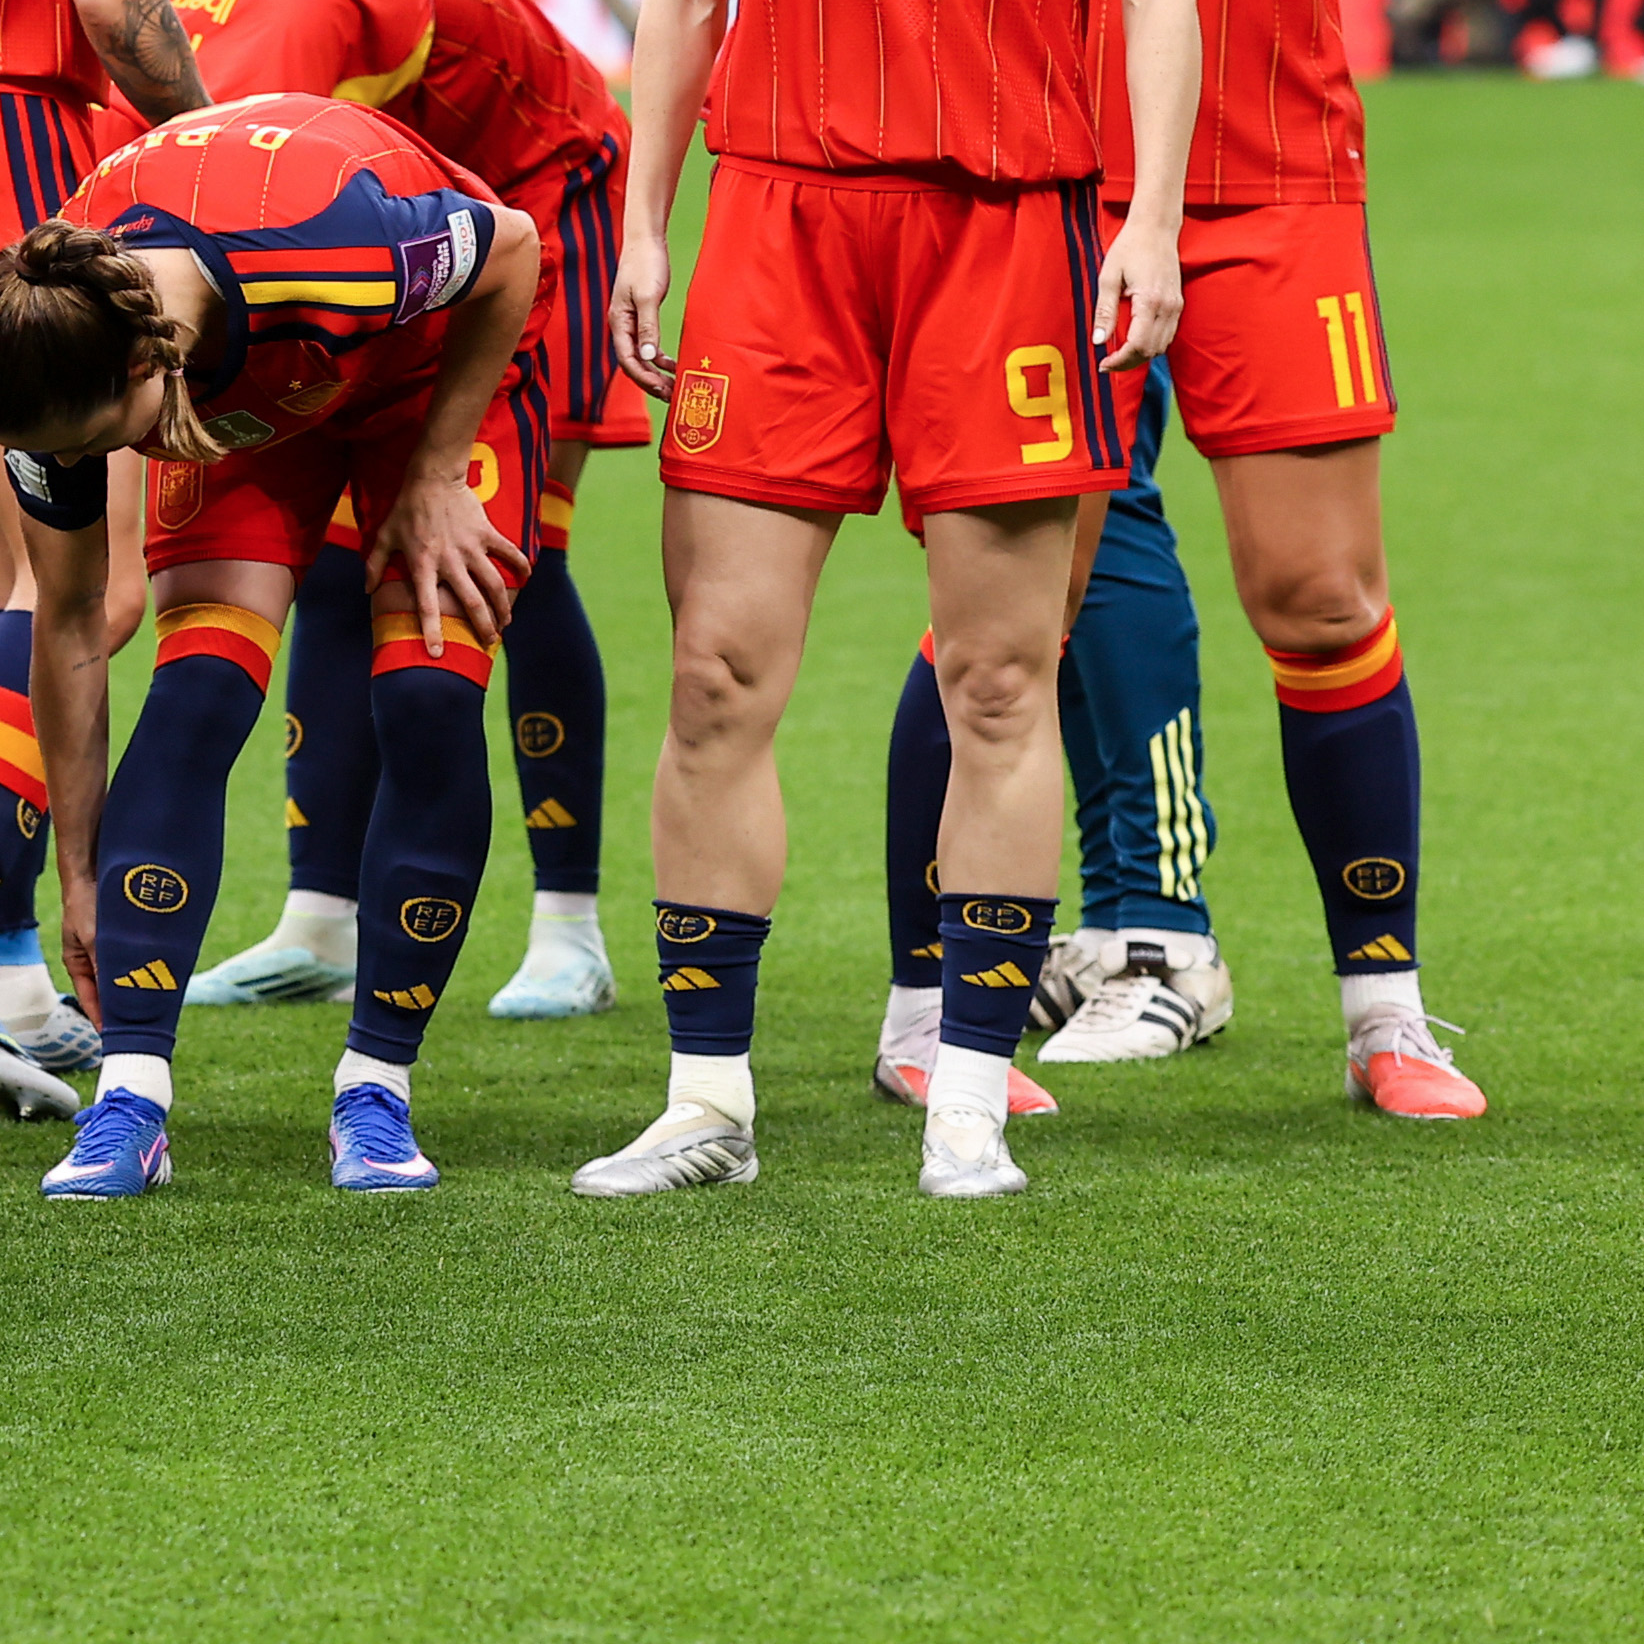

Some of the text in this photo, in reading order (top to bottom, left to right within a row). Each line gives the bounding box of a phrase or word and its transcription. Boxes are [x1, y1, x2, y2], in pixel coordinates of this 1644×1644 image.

[1317, 292, 1377, 408] 11
[1005, 345, 1073, 464] 9
[140, 872, 177, 889] RF
[139, 887, 174, 903] EF
[415, 904, 451, 920] RF
[413, 918, 449, 933] EF
